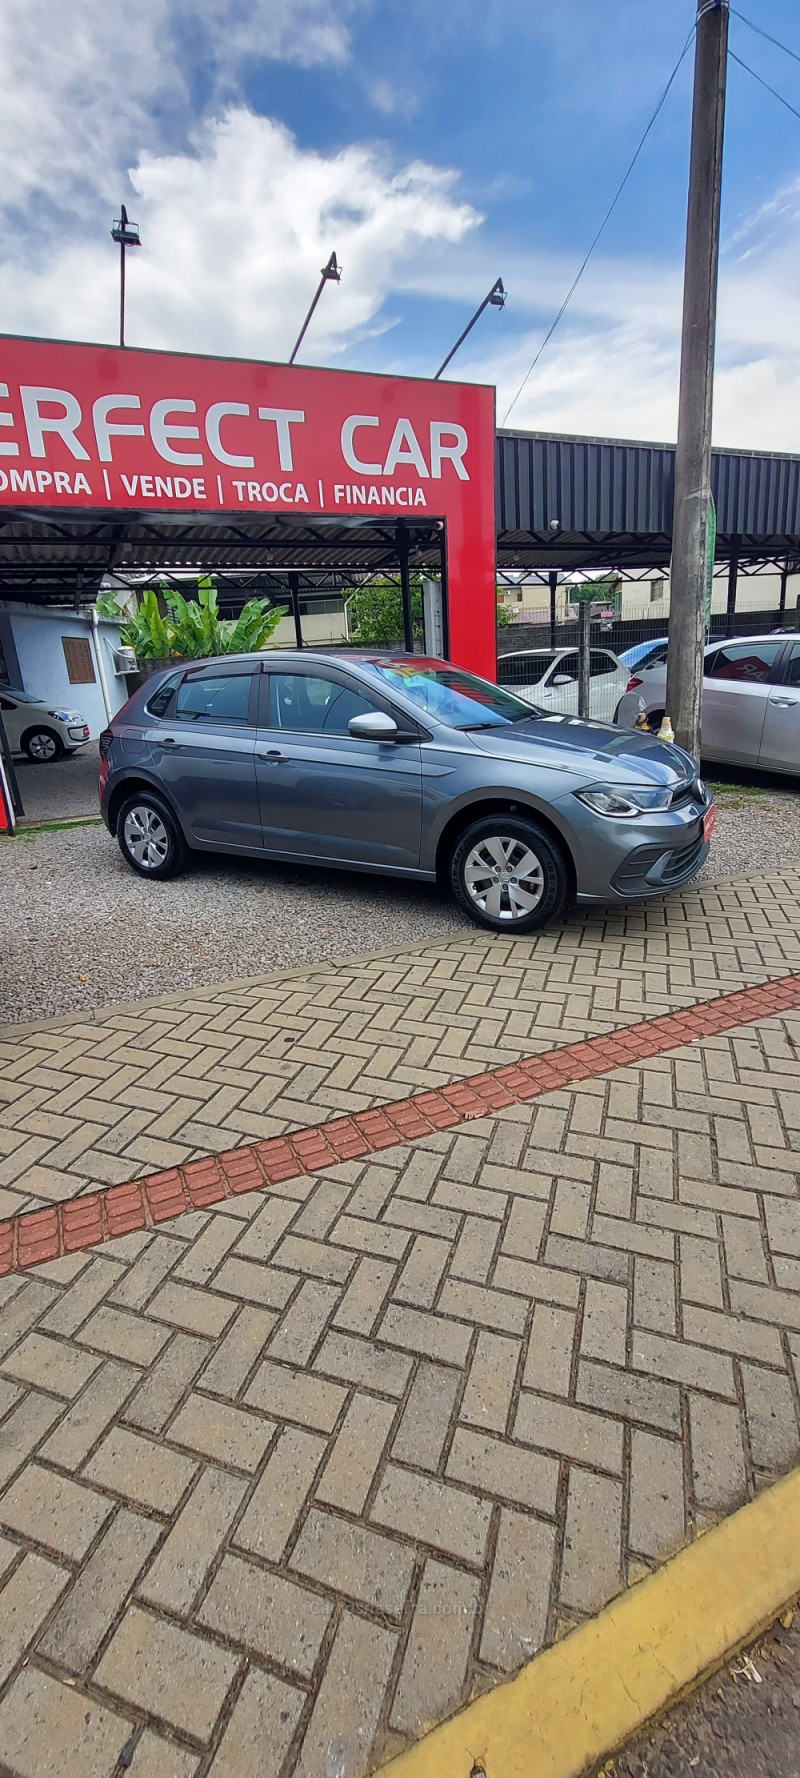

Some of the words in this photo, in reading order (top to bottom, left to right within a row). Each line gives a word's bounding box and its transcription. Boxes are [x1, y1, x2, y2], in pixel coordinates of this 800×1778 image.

[341, 414, 470, 481] CAR
[120, 474, 207, 499] VENDE
[232, 481, 310, 503] TROCA
[334, 485, 427, 507] FINANCIA
